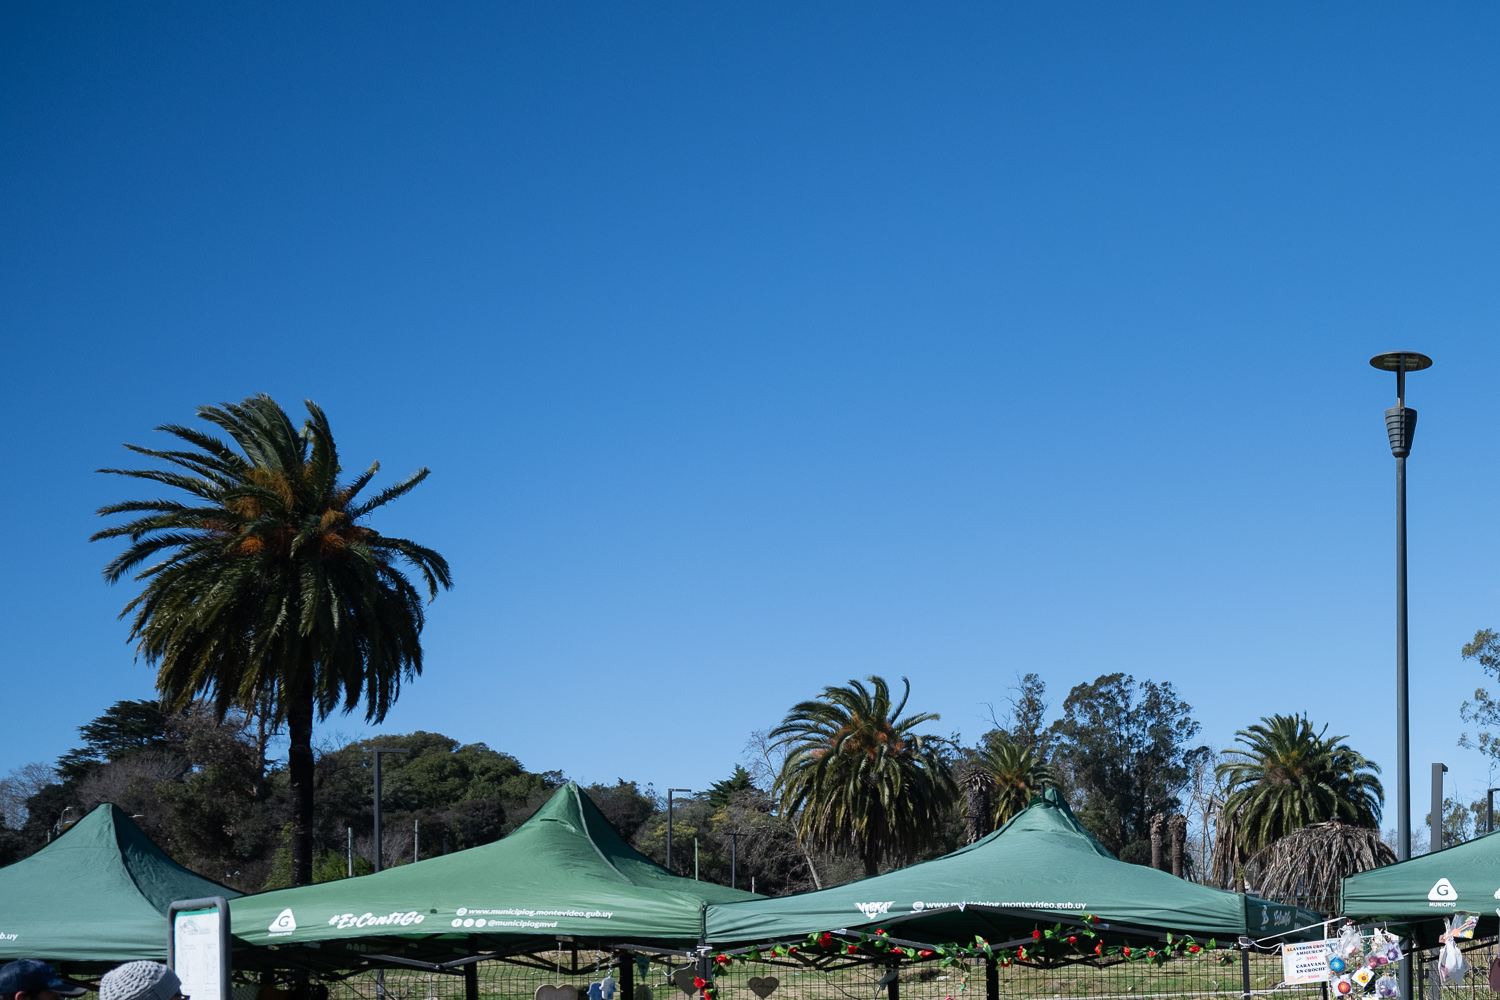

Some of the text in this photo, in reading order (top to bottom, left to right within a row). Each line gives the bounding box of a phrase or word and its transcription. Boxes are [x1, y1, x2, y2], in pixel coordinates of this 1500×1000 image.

[468, 908, 614, 919] www.municipiog.montevideo.gub.uy
[328, 911, 426, 929] #EsContiGo
[487, 918, 558, 929] @municipiogmvd
